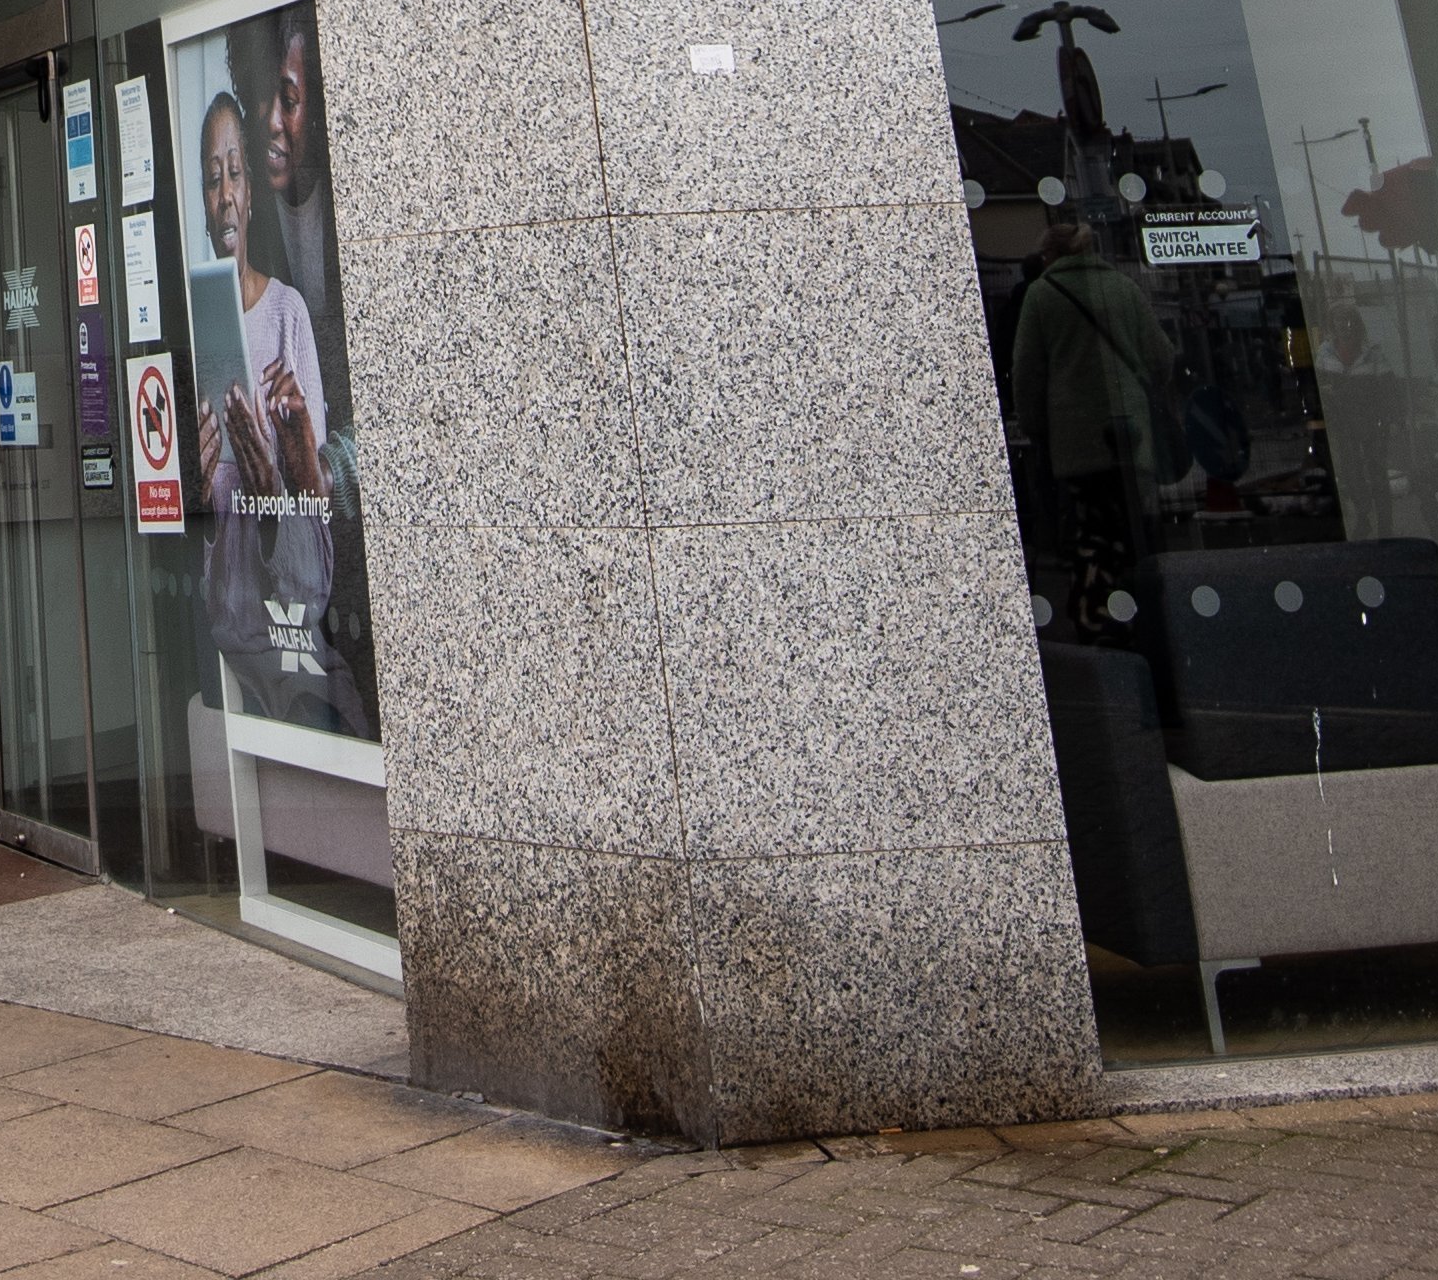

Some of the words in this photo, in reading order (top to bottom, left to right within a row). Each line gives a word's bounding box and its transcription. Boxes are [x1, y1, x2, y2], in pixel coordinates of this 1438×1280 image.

[1145, 212, 1195, 222] CURRENT
[1198, 210, 1247, 221] ACCOUNT
[1148, 231, 1199, 243] SWITCH
[1151, 242, 1248, 258] GUARANTEE
[4, 286, 39, 310] HALIFAX
[149, 486, 158, 498] No
[158, 485, 171, 500] dogs
[231, 489, 246, 515] It's
[249, 498, 255, 514] a
[258, 490, 296, 522] people
[298, 489, 333, 524] thing.
[268, 626, 317, 652] HALIFAX
